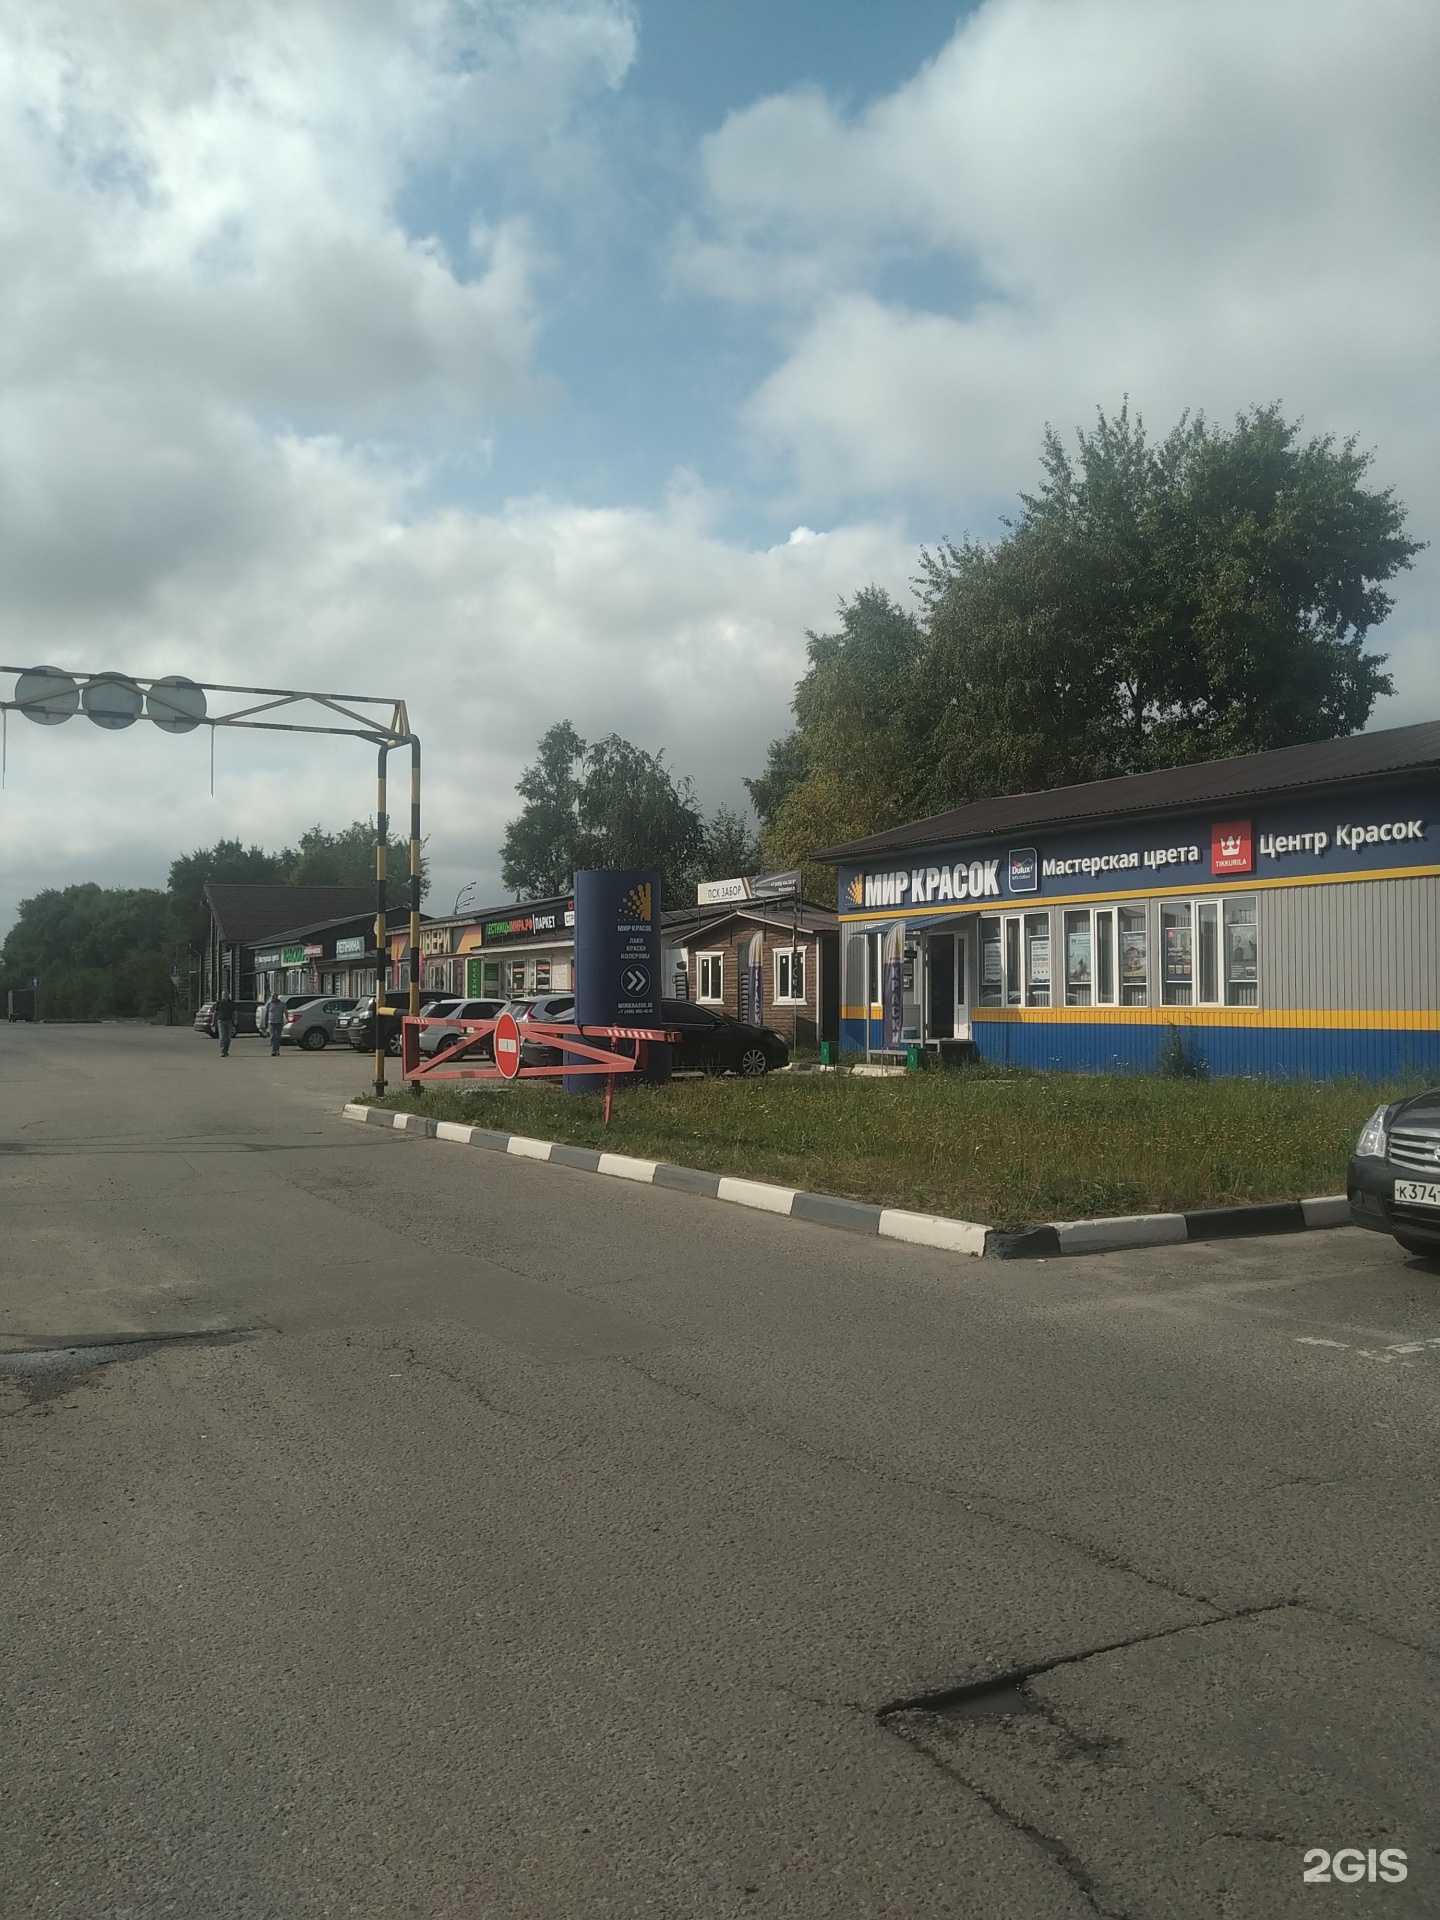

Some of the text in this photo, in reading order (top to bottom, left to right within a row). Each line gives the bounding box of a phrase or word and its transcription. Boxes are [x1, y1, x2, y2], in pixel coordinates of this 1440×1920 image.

[1259, 819, 1424, 858] Центр Красок
[1011, 864, 1032, 875] Dulux
[1042, 846, 1199, 877] Мастерская цвета
[1215, 858, 1248, 868] TIKKURILA
[865, 859, 1000, 907] МИР КРАСОК
[535, 915, 555, 930] ПАРКЕТ
[1399, 1183, 1440, 1203] К374
